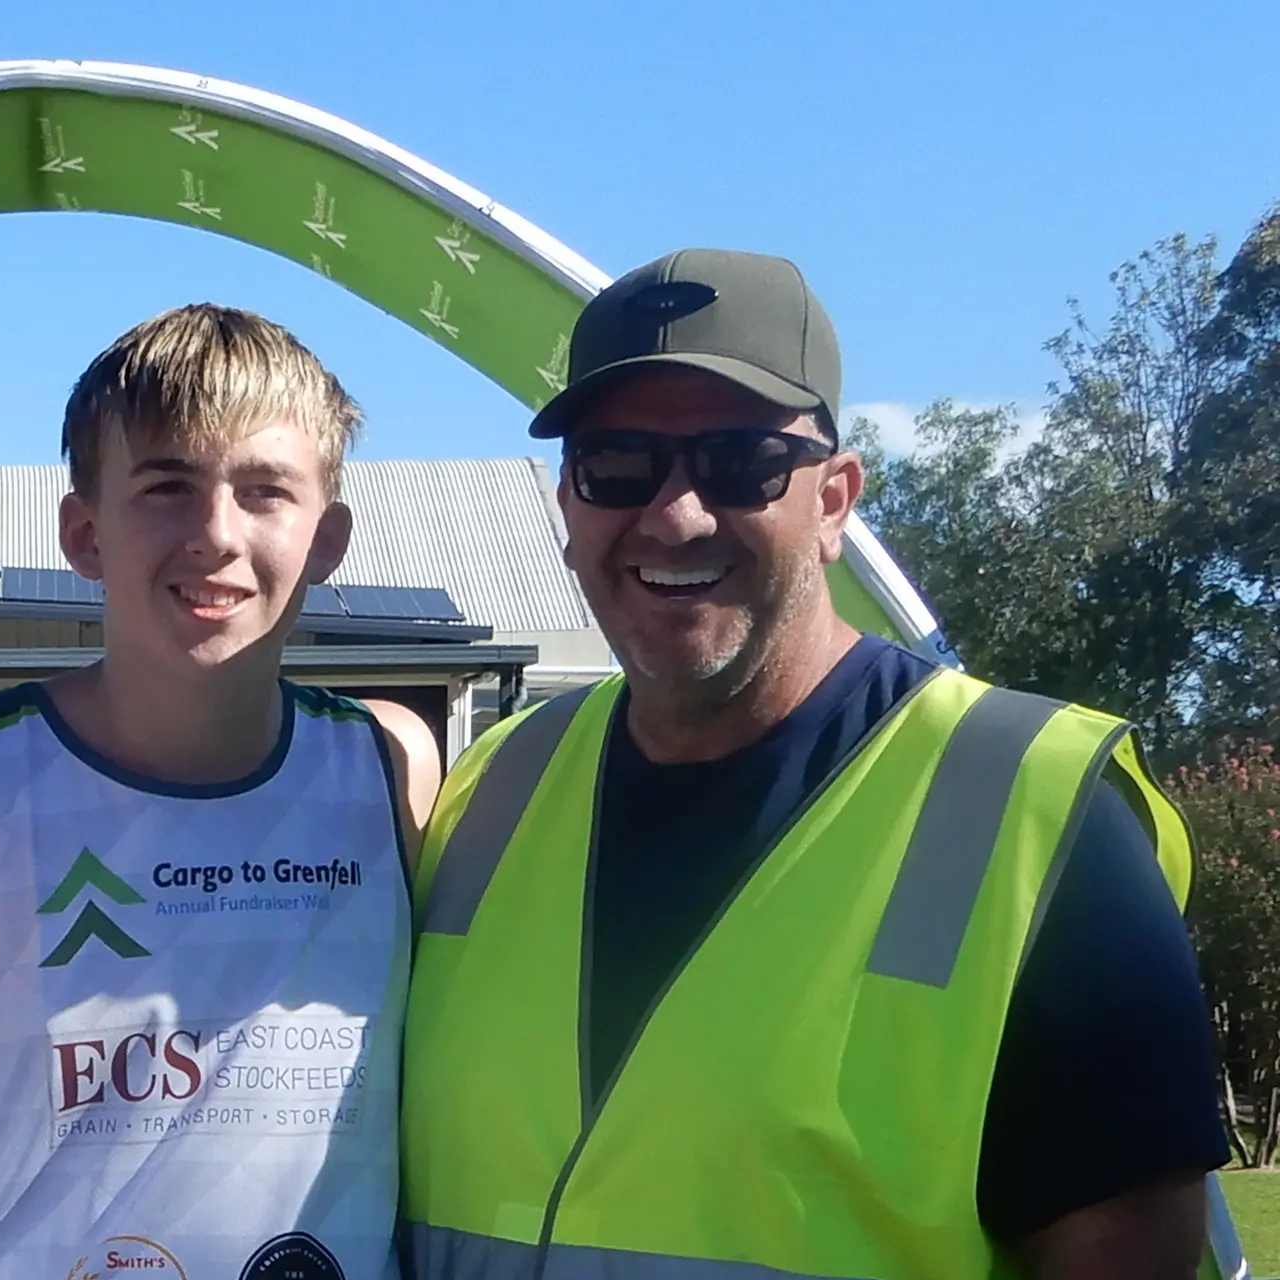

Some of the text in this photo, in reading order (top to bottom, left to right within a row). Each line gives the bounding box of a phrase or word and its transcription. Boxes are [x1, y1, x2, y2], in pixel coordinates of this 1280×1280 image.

[153, 858, 362, 893] Cargo to Grenfell
[155, 896, 216, 916] Annual
[220, 895, 299, 912] Fundraiser
[216, 1025, 371, 1053] EAST COAST
[52, 1029, 202, 1112] ECS
[215, 1063, 366, 1091] STOCKFEEDS
[57, 1117, 116, 1139] GRAIN
[142, 1108, 253, 1133] TRANSPORT
